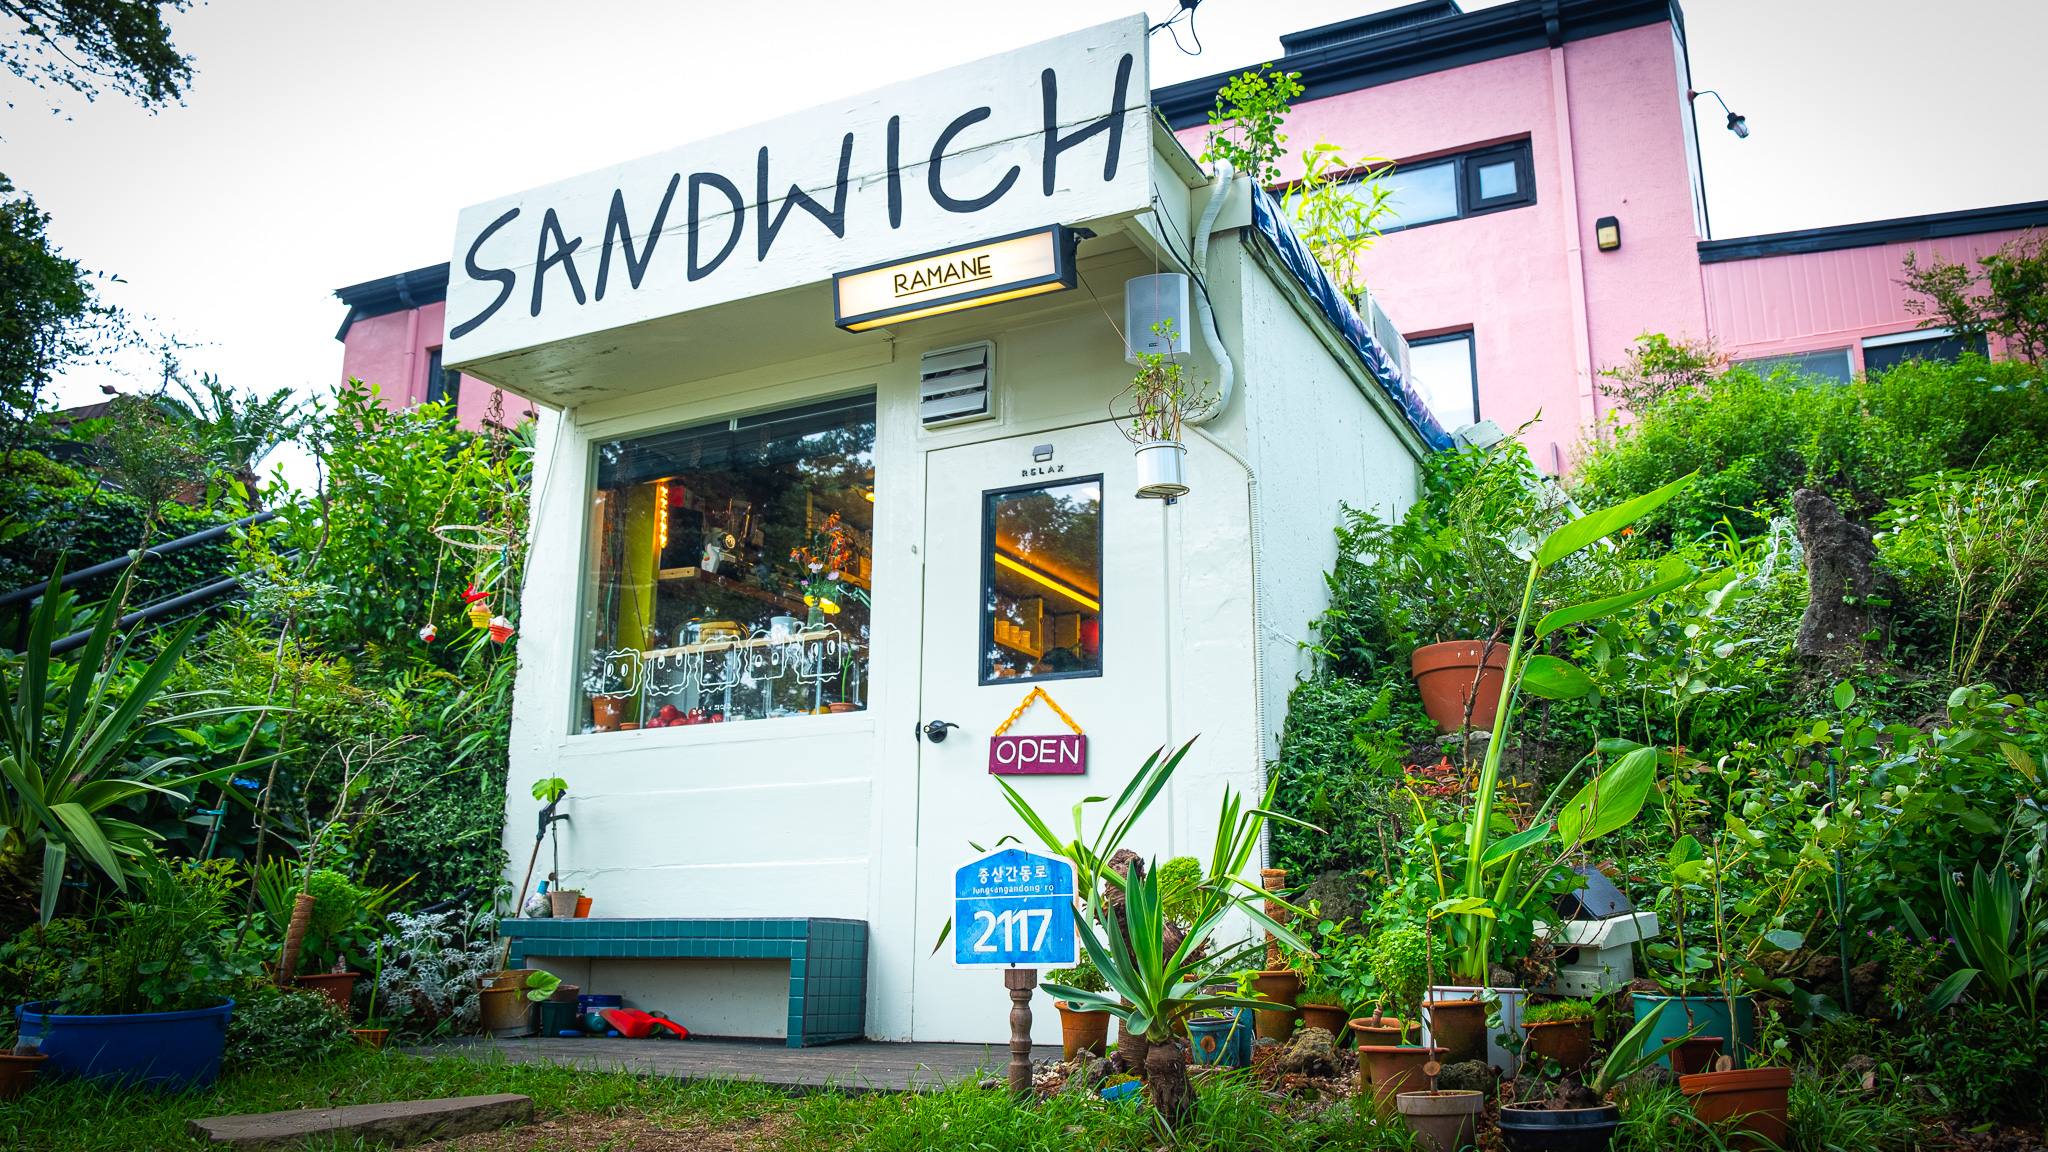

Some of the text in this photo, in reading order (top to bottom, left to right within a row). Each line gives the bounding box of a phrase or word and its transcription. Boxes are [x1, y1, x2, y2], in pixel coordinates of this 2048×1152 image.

[450, 53, 1133, 340] SANDWICH
[894, 254, 992, 294] RAMANE
[996, 739, 1079, 769] OPEN
[977, 865, 1048, 884] 중산간동로
[973, 909, 1053, 952] 2117
